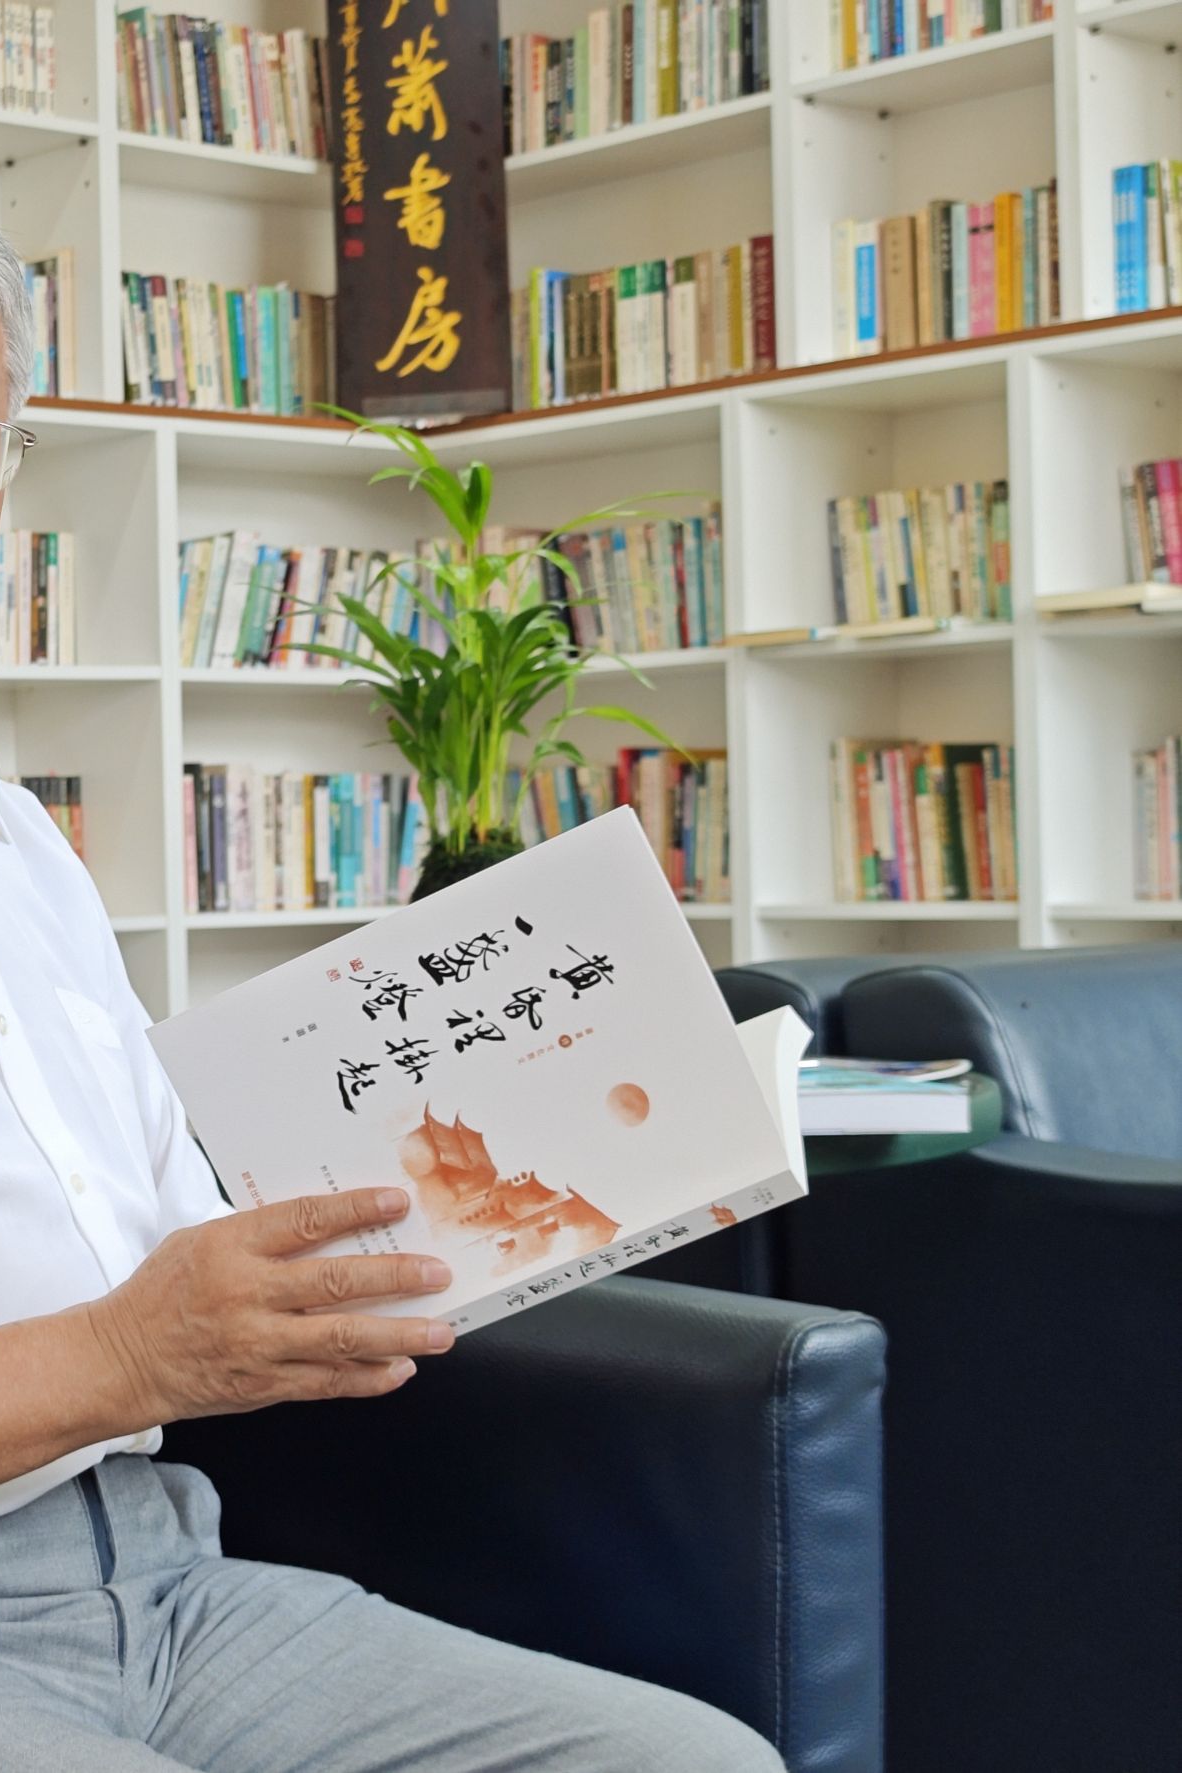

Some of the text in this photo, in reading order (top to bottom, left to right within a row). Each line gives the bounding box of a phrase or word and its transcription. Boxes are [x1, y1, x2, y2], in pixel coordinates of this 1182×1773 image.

[374, 0, 463, 378] 蕭書房
[348, 915, 535, 1022] 一盞燈
